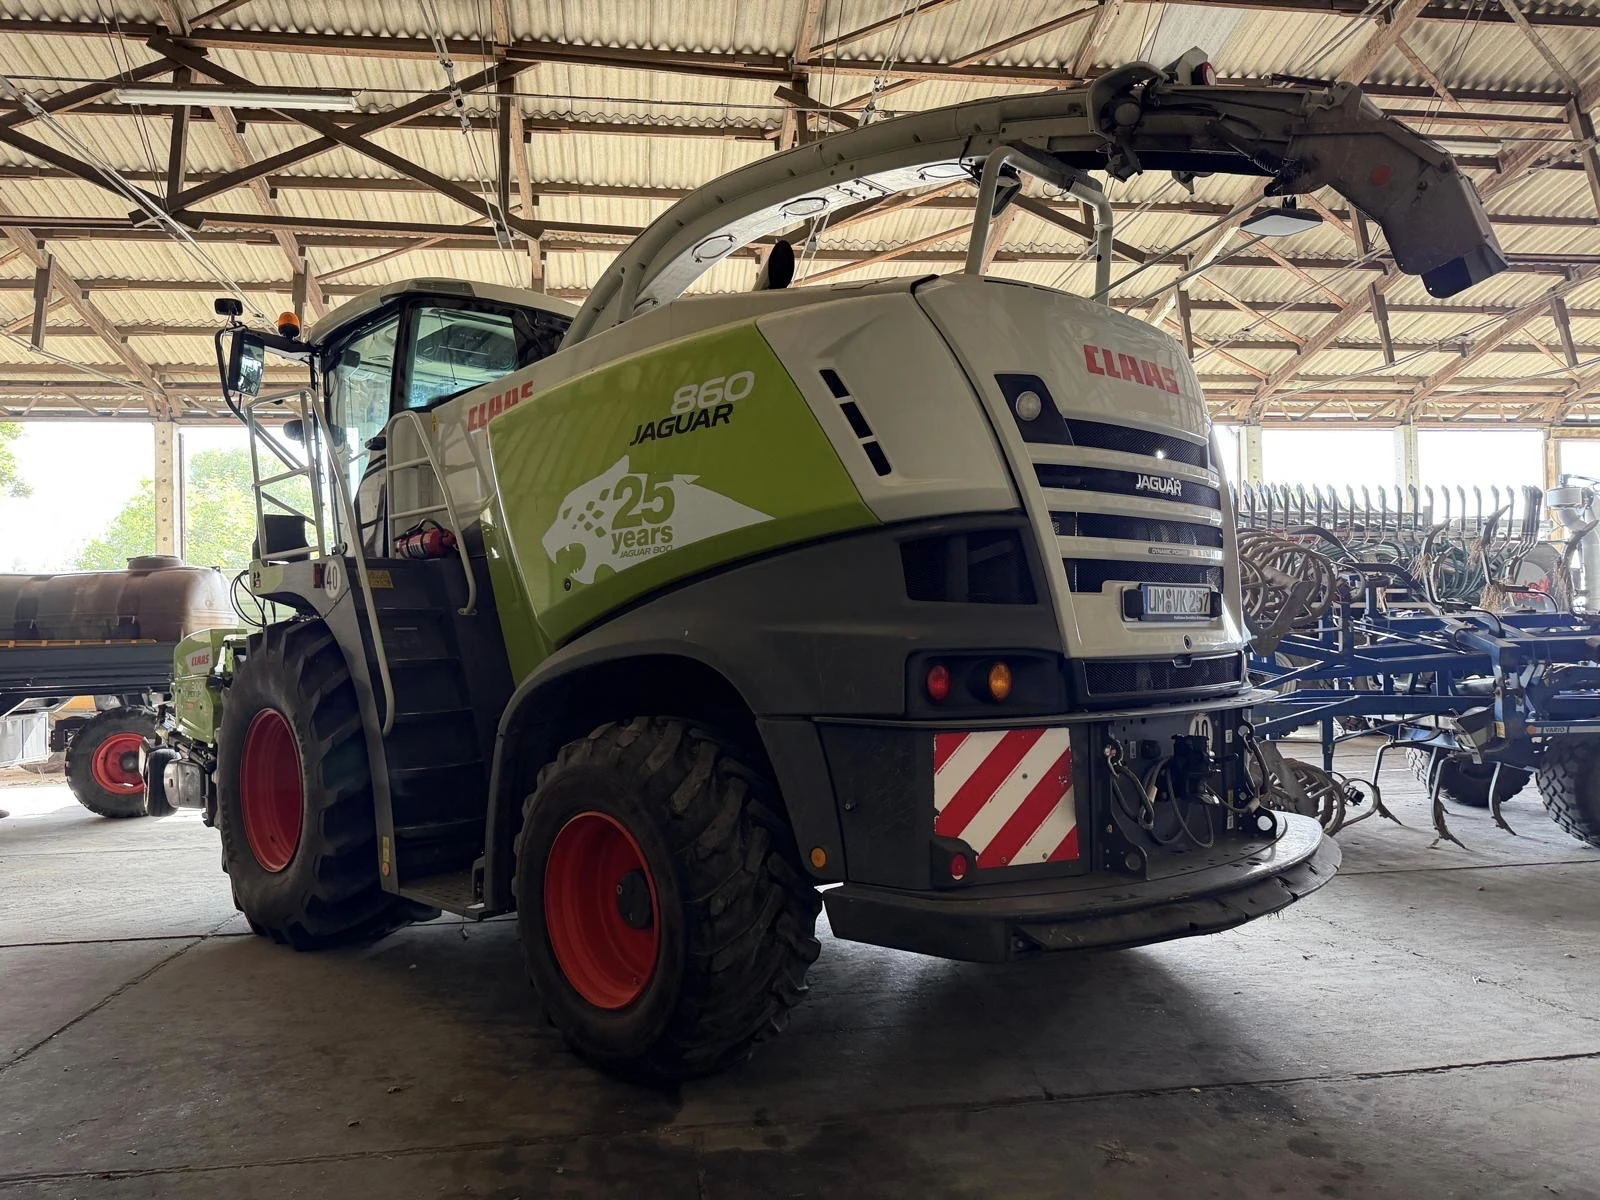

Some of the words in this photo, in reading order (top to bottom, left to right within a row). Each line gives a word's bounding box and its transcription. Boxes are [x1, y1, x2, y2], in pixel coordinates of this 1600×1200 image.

[1083, 344, 1180, 395] CLAAS
[671, 370, 755, 415] 860
[629, 403, 734, 446] JAGUAR
[1135, 474, 1182, 497] JAGUAR
[611, 472, 676, 530] 25
[611, 525, 673, 555] years
[620, 547, 652, 559] JAGUAR
[326, 565, 338, 591] 40
[1189, 589, 1209, 613] 257
[191, 655, 210, 667] CLAAS
